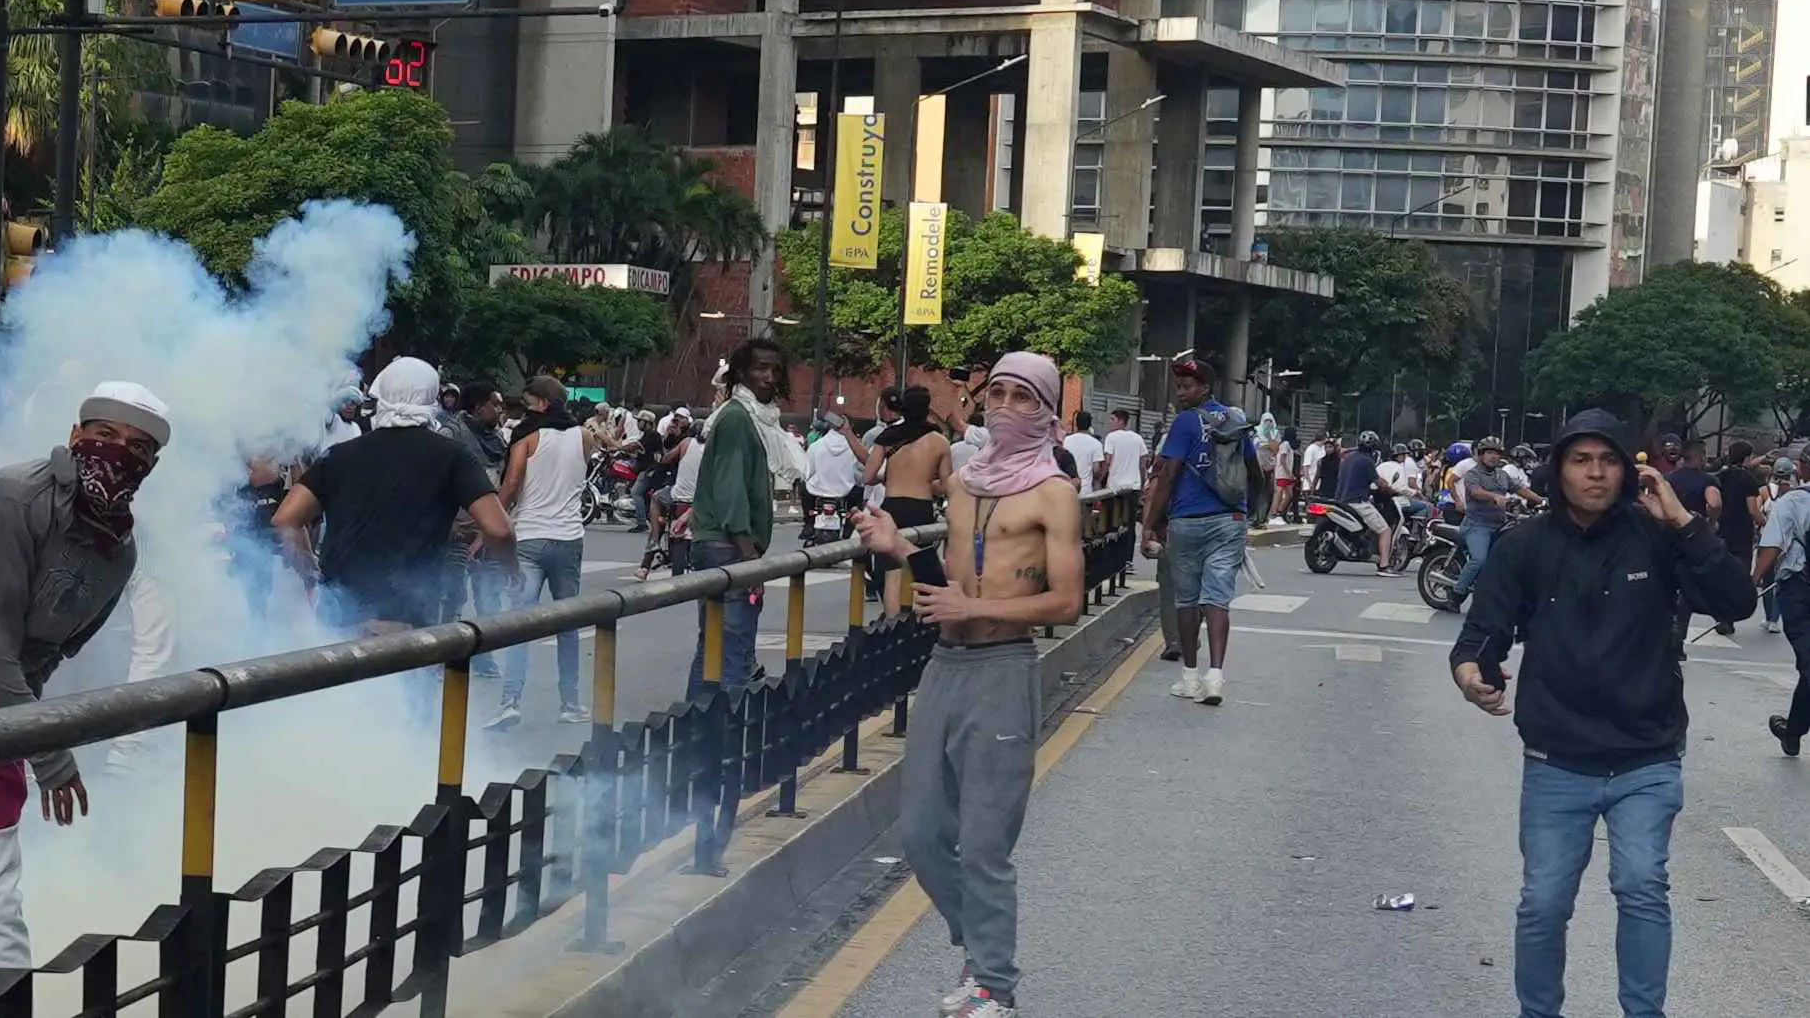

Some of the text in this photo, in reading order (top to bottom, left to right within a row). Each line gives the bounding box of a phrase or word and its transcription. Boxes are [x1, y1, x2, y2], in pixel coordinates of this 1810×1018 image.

[851, 114, 885, 236] Construya
[845, 246, 869, 258] EPA
[920, 205, 941, 300] Remodele
